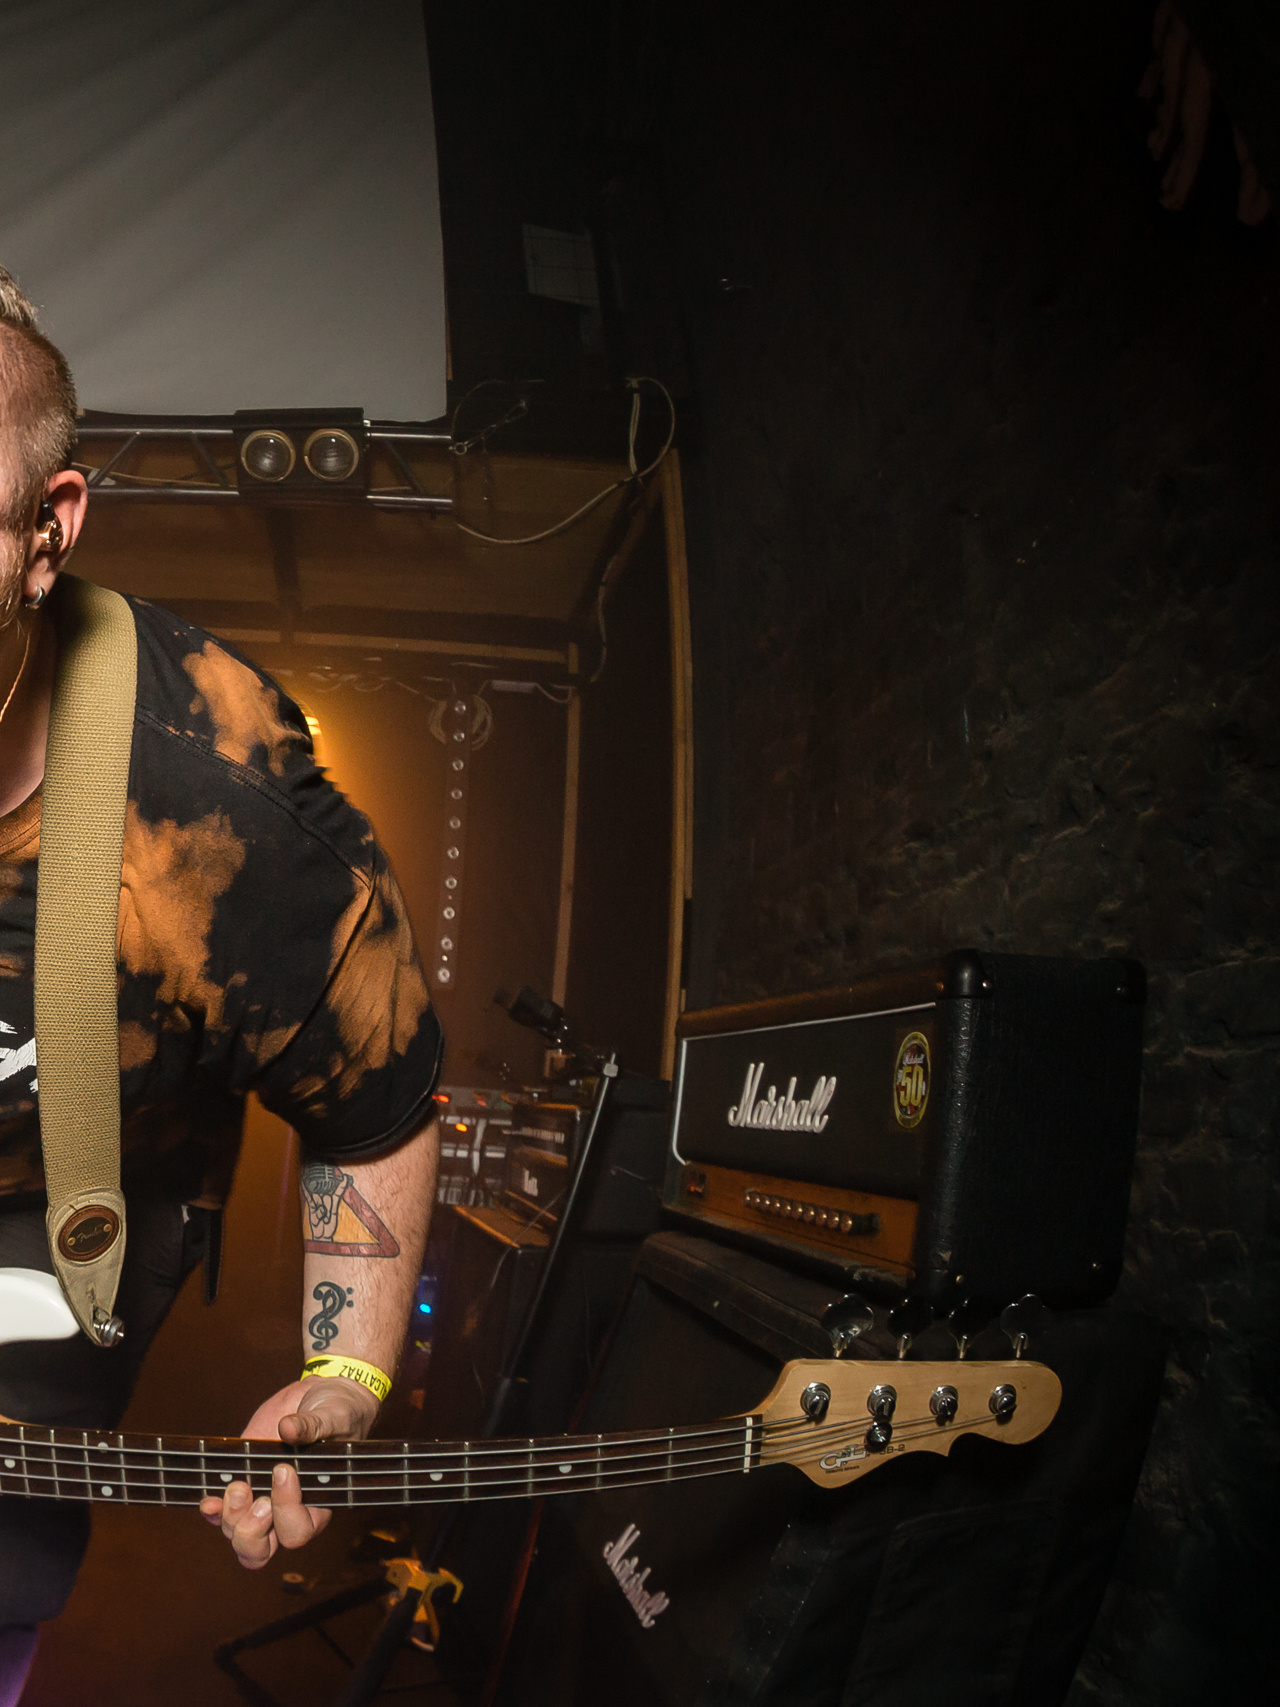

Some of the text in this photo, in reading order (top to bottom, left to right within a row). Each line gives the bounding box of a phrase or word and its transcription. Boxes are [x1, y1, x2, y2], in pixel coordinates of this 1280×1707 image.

[728, 1061, 837, 1134] Marshall
[900, 1063, 924, 1107] 50
[603, 1522, 670, 1629] Marshall
